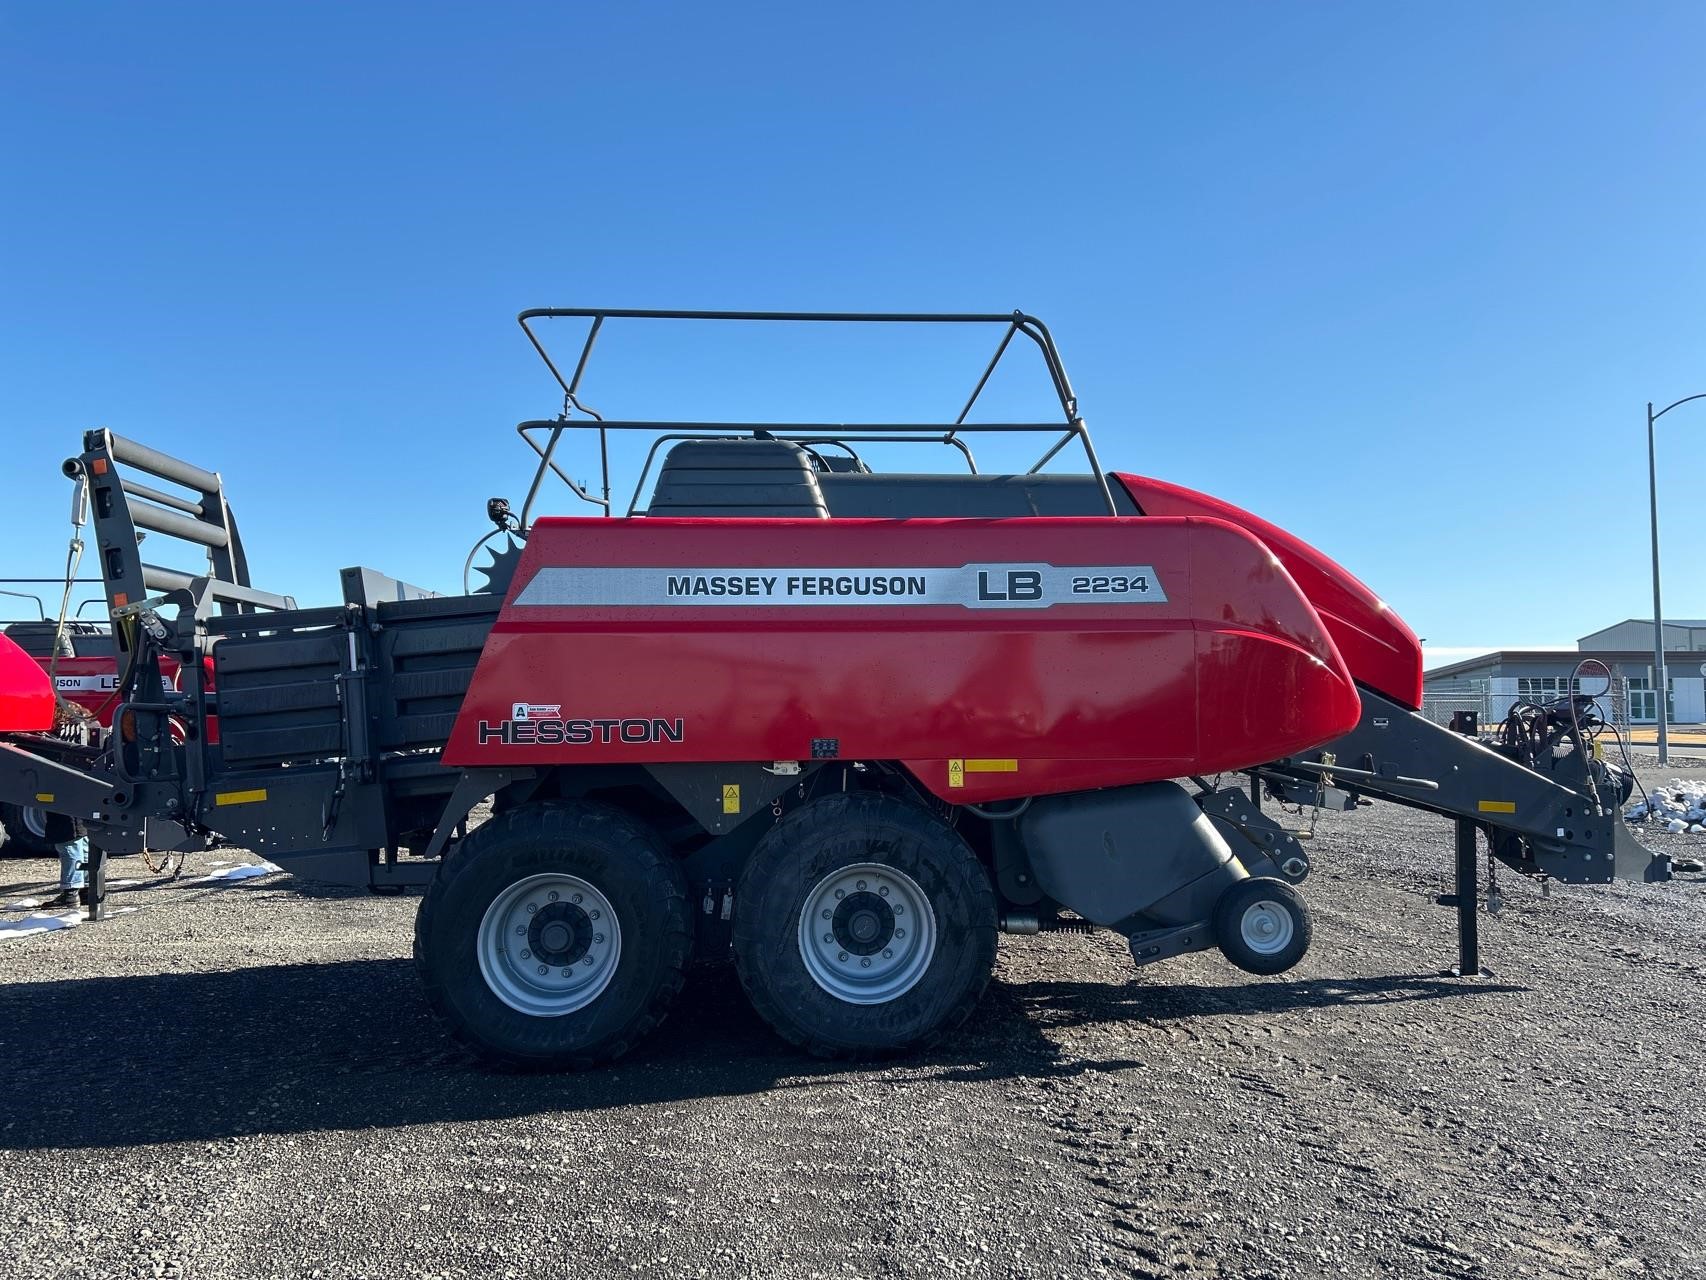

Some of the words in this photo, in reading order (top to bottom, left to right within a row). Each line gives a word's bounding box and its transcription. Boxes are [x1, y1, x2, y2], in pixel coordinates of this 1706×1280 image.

[667, 576, 777, 596] MASSEY
[787, 576, 926, 596] FERGUSON
[978, 571, 1043, 601] LB
[1072, 577, 1149, 593] 2234
[479, 719, 684, 744] HESSTON
